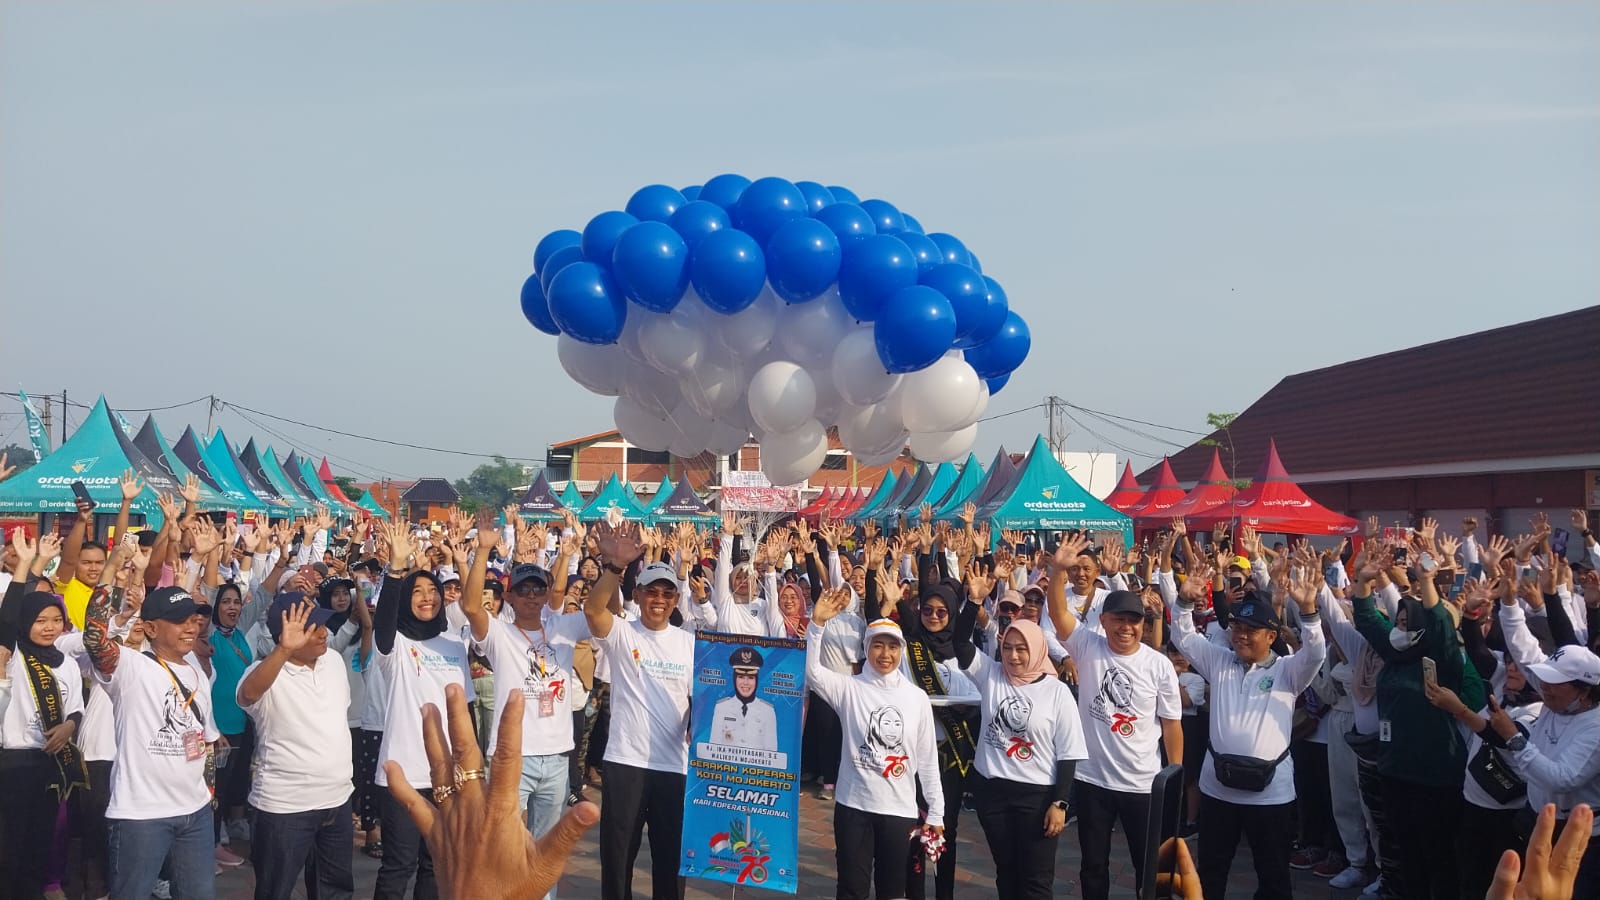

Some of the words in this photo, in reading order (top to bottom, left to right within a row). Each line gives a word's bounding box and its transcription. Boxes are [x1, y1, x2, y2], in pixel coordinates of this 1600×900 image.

[689, 759, 738, 773] GERAKAN
[741, 766, 796, 781] KOPERASI
[696, 771, 722, 781] KOTA
[726, 775, 792, 791] MOJOKERTO
[707, 785, 779, 807] SELAMAT
[693, 798, 711, 807] HARI
[750, 807, 790, 819] NASIONAL
